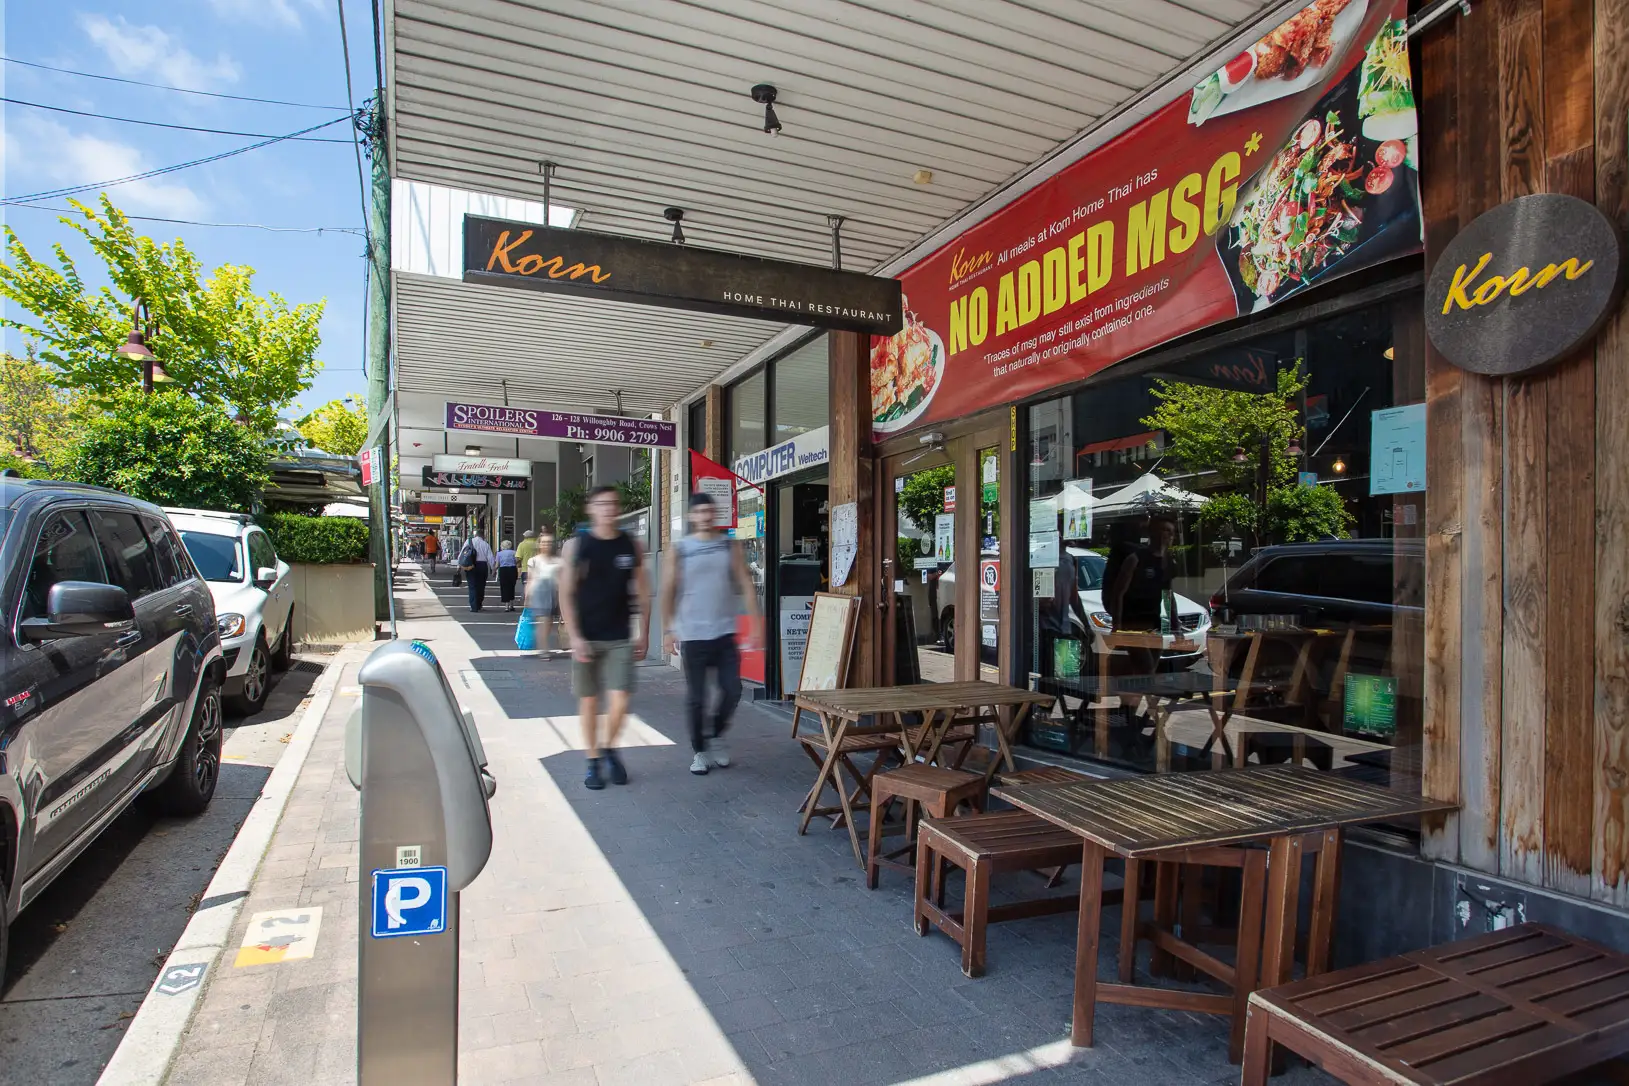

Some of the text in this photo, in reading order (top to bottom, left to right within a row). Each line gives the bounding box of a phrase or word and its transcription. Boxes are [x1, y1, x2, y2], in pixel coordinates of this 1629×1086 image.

[997, 252, 1009, 267] All
[1010, 239, 1036, 261] meals
[1037, 231, 1048, 245] at
[1072, 197, 1104, 223] Home
[1107, 178, 1133, 204] Thai
[1135, 167, 1158, 189] has
[486, 229, 612, 284] Korn
[949, 247, 994, 285] Korn
[949, 286, 988, 356] NO
[995, 220, 1115, 337] ADDED
[1442, 251, 1595, 316] Korn
[723, 291, 893, 323] HOME THAI RESTAURANT
[1011, 341, 1021, 355] of
[1021, 336, 1037, 352] msg
[1039, 329, 1057, 346] may
[1058, 322, 1074, 338] still
[1075, 314, 1093, 331] exist
[1094, 303, 1114, 322] from
[1115, 277, 1170, 312] ingredients
[993, 303, 1156, 378] that naturally or originally contained one.
[454, 404, 538, 430] SPOILERS
[468, 418, 524, 429] INTERNATIONAL
[551, 413, 563, 421] 126
[570, 415, 580, 423] 128
[582, 416, 617, 427] Willoughby
[619, 420, 637, 429] Road,
[639, 422, 657, 430] Crows
[660, 423, 673, 431] Nest
[566, 425, 659, 444] Ph: 9906 2799
[736, 442, 827, 486] COMPUTER Weltech
[399, 857, 419, 865] 1900
[385, 877, 432, 929] P
